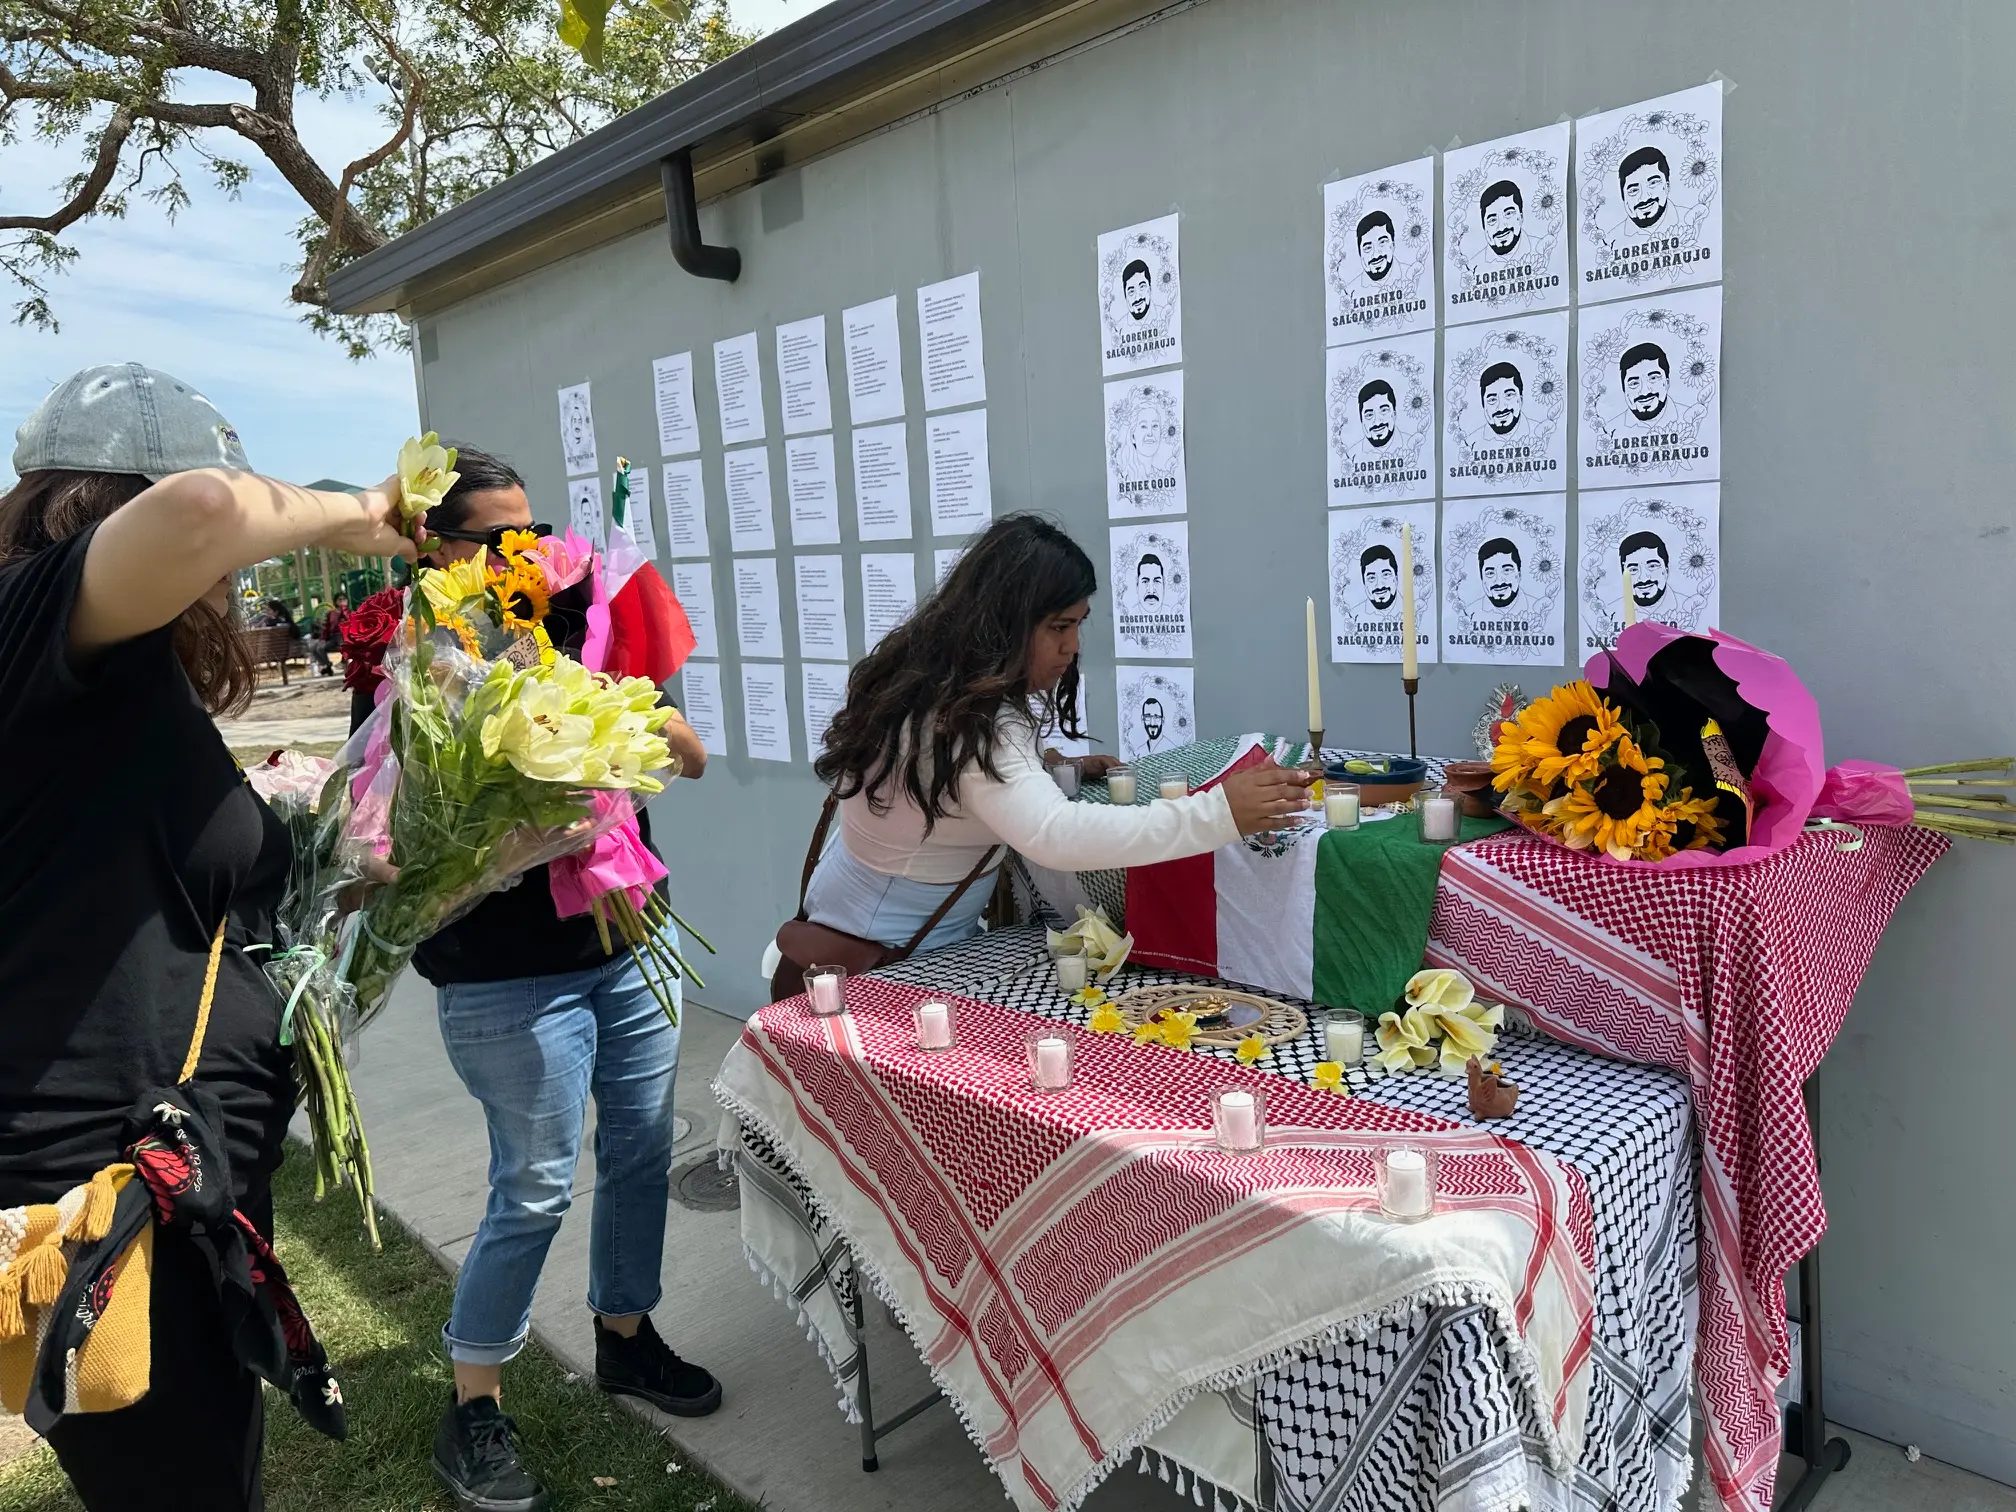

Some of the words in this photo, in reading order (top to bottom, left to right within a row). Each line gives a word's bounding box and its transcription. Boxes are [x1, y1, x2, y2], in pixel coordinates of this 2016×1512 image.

[1585, 260, 1650, 283] SALGADO
[1652, 247, 1711, 270] ARAUJO
[1451, 286, 1507, 305] SALGADO
[1509, 275, 1559, 294] ARAUJO
[1332, 309, 1380, 326] SALGADO
[1382, 299, 1427, 318] ARAUJO
[1106, 343, 1141, 359] SALGADO
[1143, 337, 1176, 352] ARAUJO
[1585, 451, 1649, 468] SALGADO
[1652, 446, 1709, 461] ARAUJO
[1449, 462, 1504, 478] SALGADO
[1506, 459, 1557, 474] ARAUJO
[1119, 480, 1149, 493] RENEE
[1150, 478, 1176, 489] GOOD
[1333, 474, 1382, 488] SALGADO
[1383, 470, 1427, 483] ARAUJO
[1120, 614, 1153, 623] ROBERTO
[1154, 614, 1184, 622] CARLOS
[1120, 626, 1154, 634] MONTOYA
[1337, 634, 1384, 645] SALGADO
[1385, 633, 1429, 645] ARJO
[1449, 634, 1503, 645] SALGADO
[1505, 634, 1555, 645] ARAUJO
